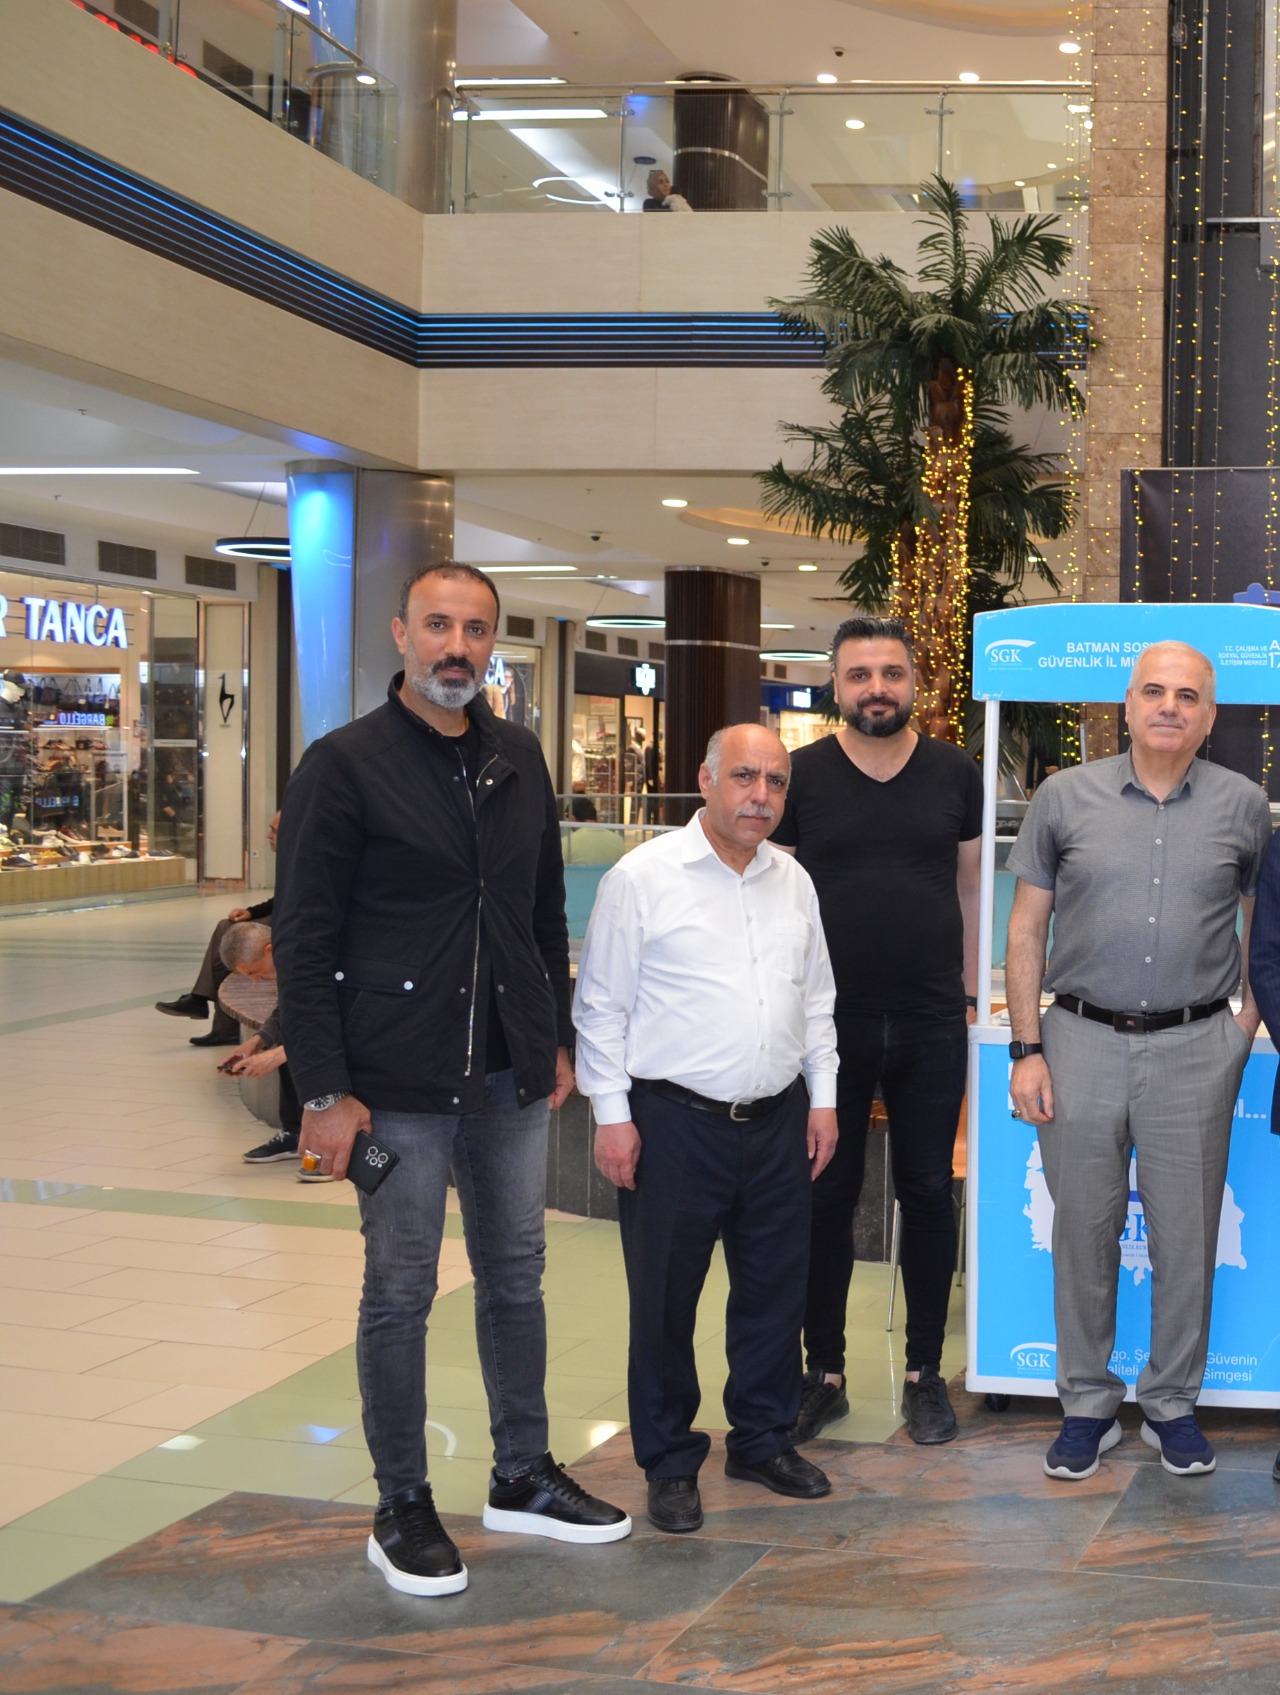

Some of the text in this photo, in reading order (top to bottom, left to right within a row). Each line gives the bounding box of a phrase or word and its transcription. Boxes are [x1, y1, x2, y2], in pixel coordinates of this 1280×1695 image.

[21, 595, 128, 649] TANCA
[1067, 641, 1154, 653] BATMAN SOS
[990, 649, 1022, 663] SGK
[1038, 654, 1103, 668] GÜVENLİK
[1106, 655, 1117, 667] İL
[1016, 1351, 1052, 1369] SGK
[1207, 1352, 1258, 1366] Güvenin
[1203, 1368, 1252, 1384] Simgesi
